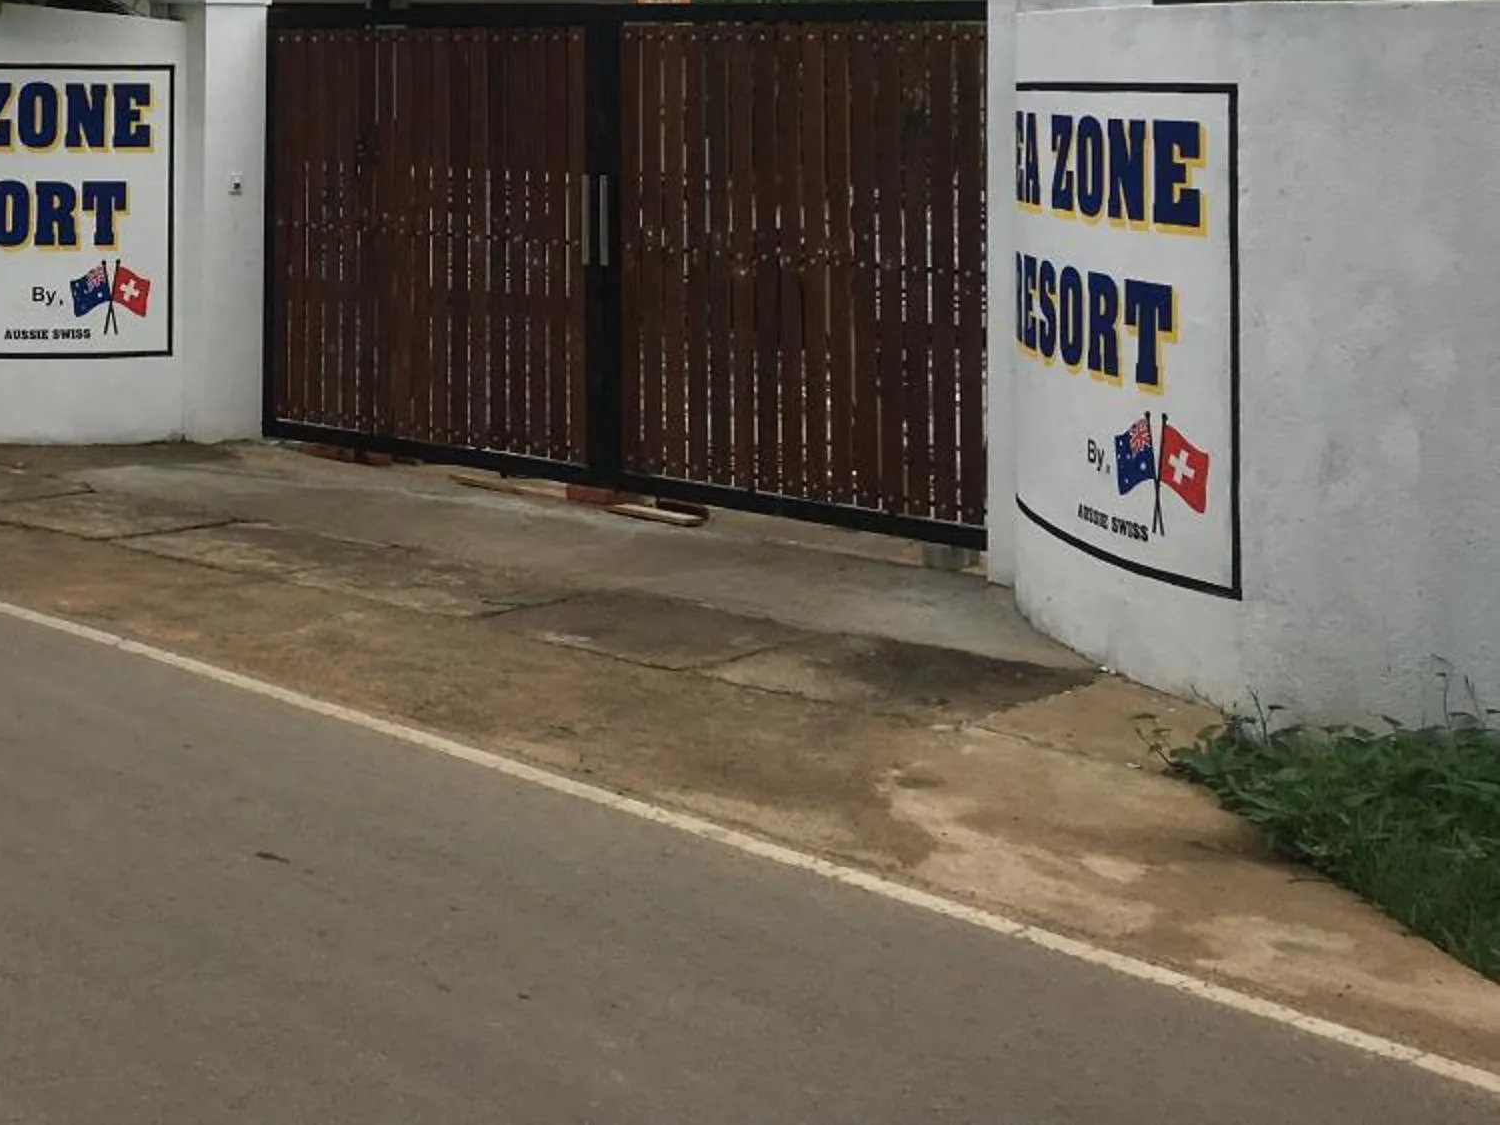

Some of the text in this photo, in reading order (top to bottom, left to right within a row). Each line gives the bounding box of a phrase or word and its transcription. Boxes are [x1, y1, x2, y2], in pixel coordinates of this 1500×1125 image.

[1051, 114, 1206, 237] ZONE
[4, 329, 92, 340] AUSSIE SWISS
[1111, 516, 1149, 542] SWISS
